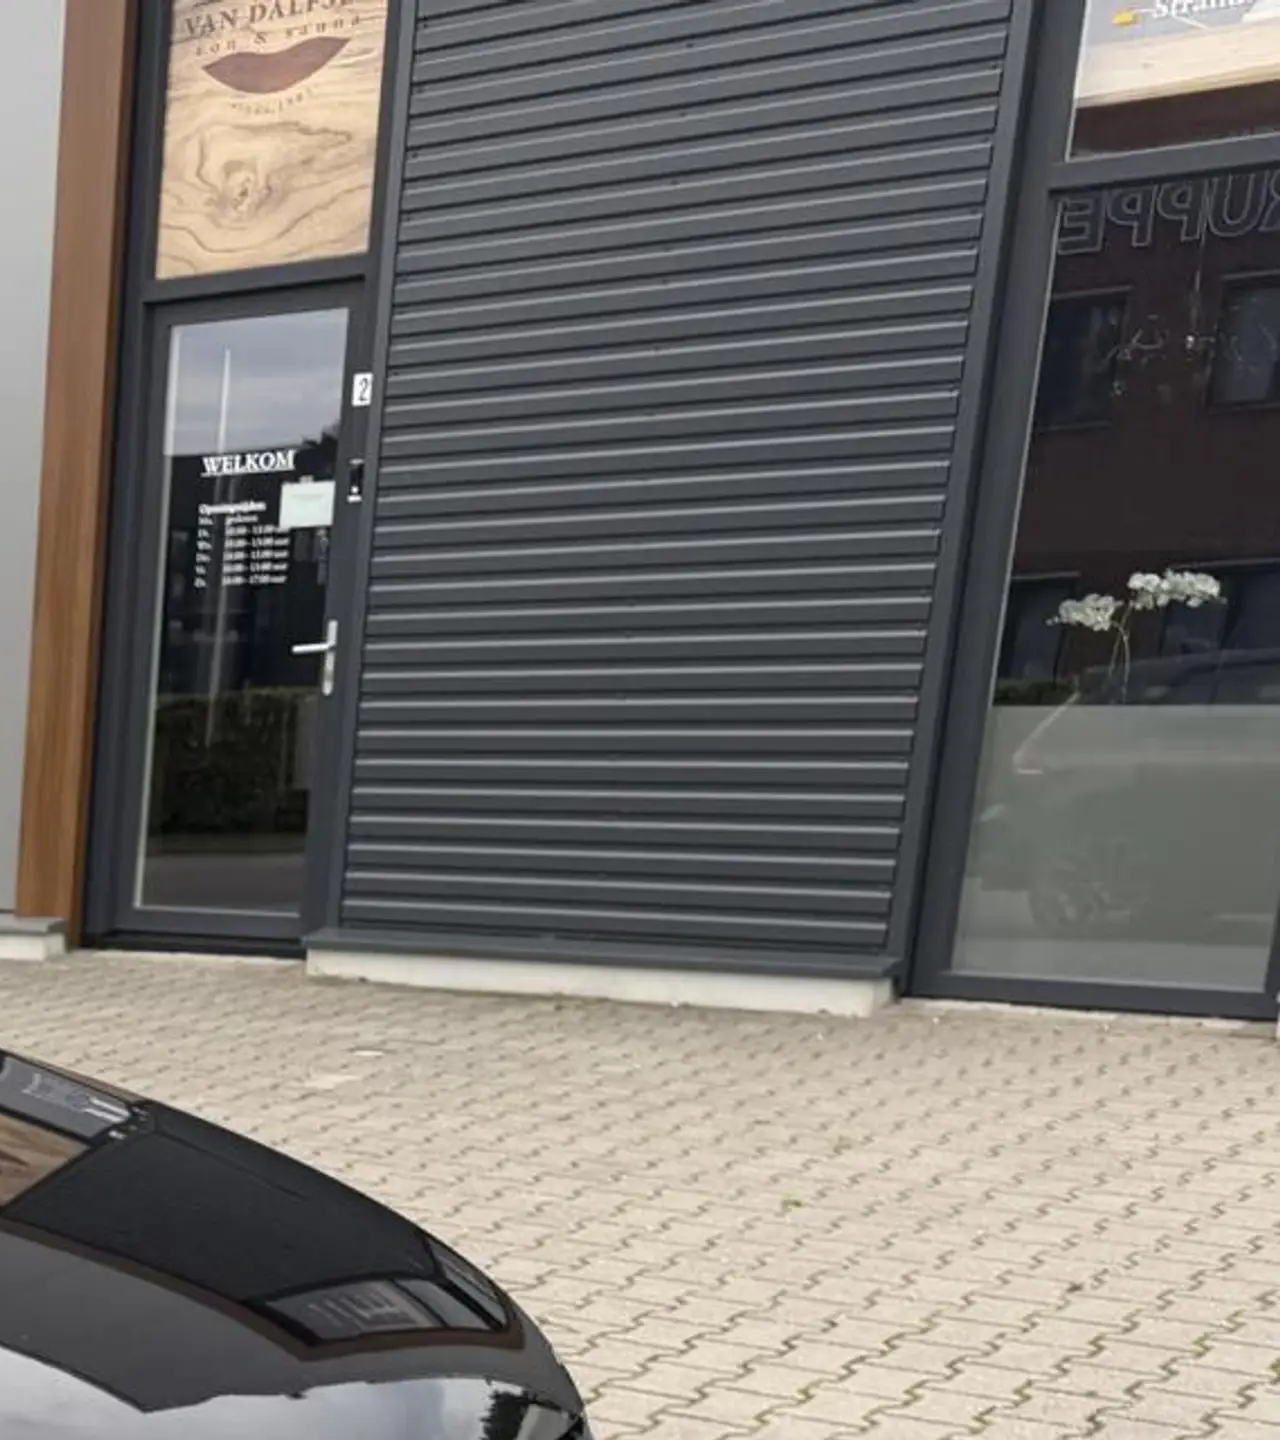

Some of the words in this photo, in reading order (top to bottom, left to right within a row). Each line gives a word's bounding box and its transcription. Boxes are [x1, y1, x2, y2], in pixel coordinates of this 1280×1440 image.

[184, 8, 238, 37] VAN
[357, 377, 370, 402] 2
[201, 449, 297, 476] WELKOM
